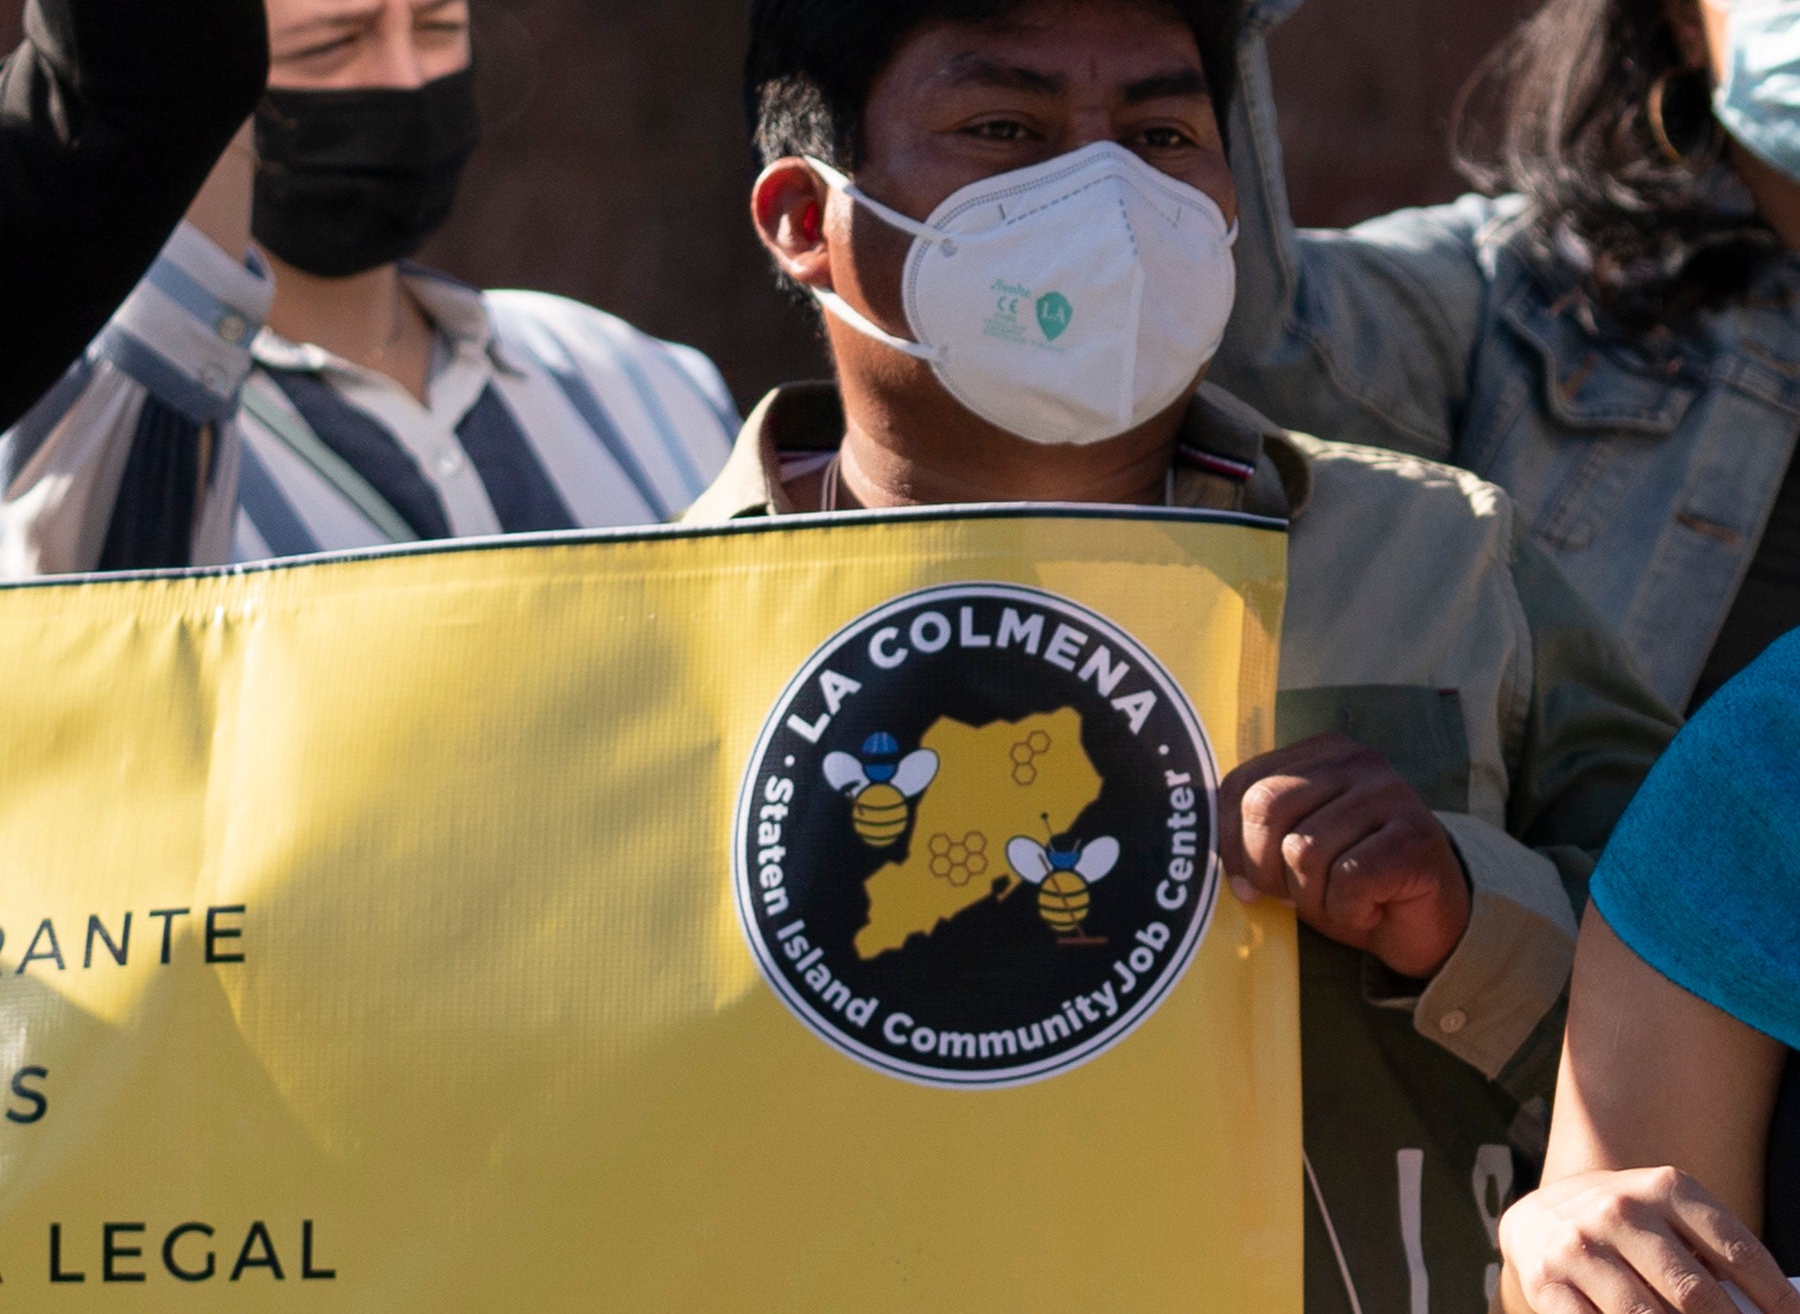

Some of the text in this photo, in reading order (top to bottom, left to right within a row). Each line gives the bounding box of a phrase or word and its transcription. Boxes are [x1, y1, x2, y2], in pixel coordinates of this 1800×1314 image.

[787, 605, 1159, 744] LA COLMENA
[0, 903, 247, 977] ANTE
[757, 768, 1198, 1060] Staten Island Community Job Center
[49, 1218, 337, 1284] LEGAL
